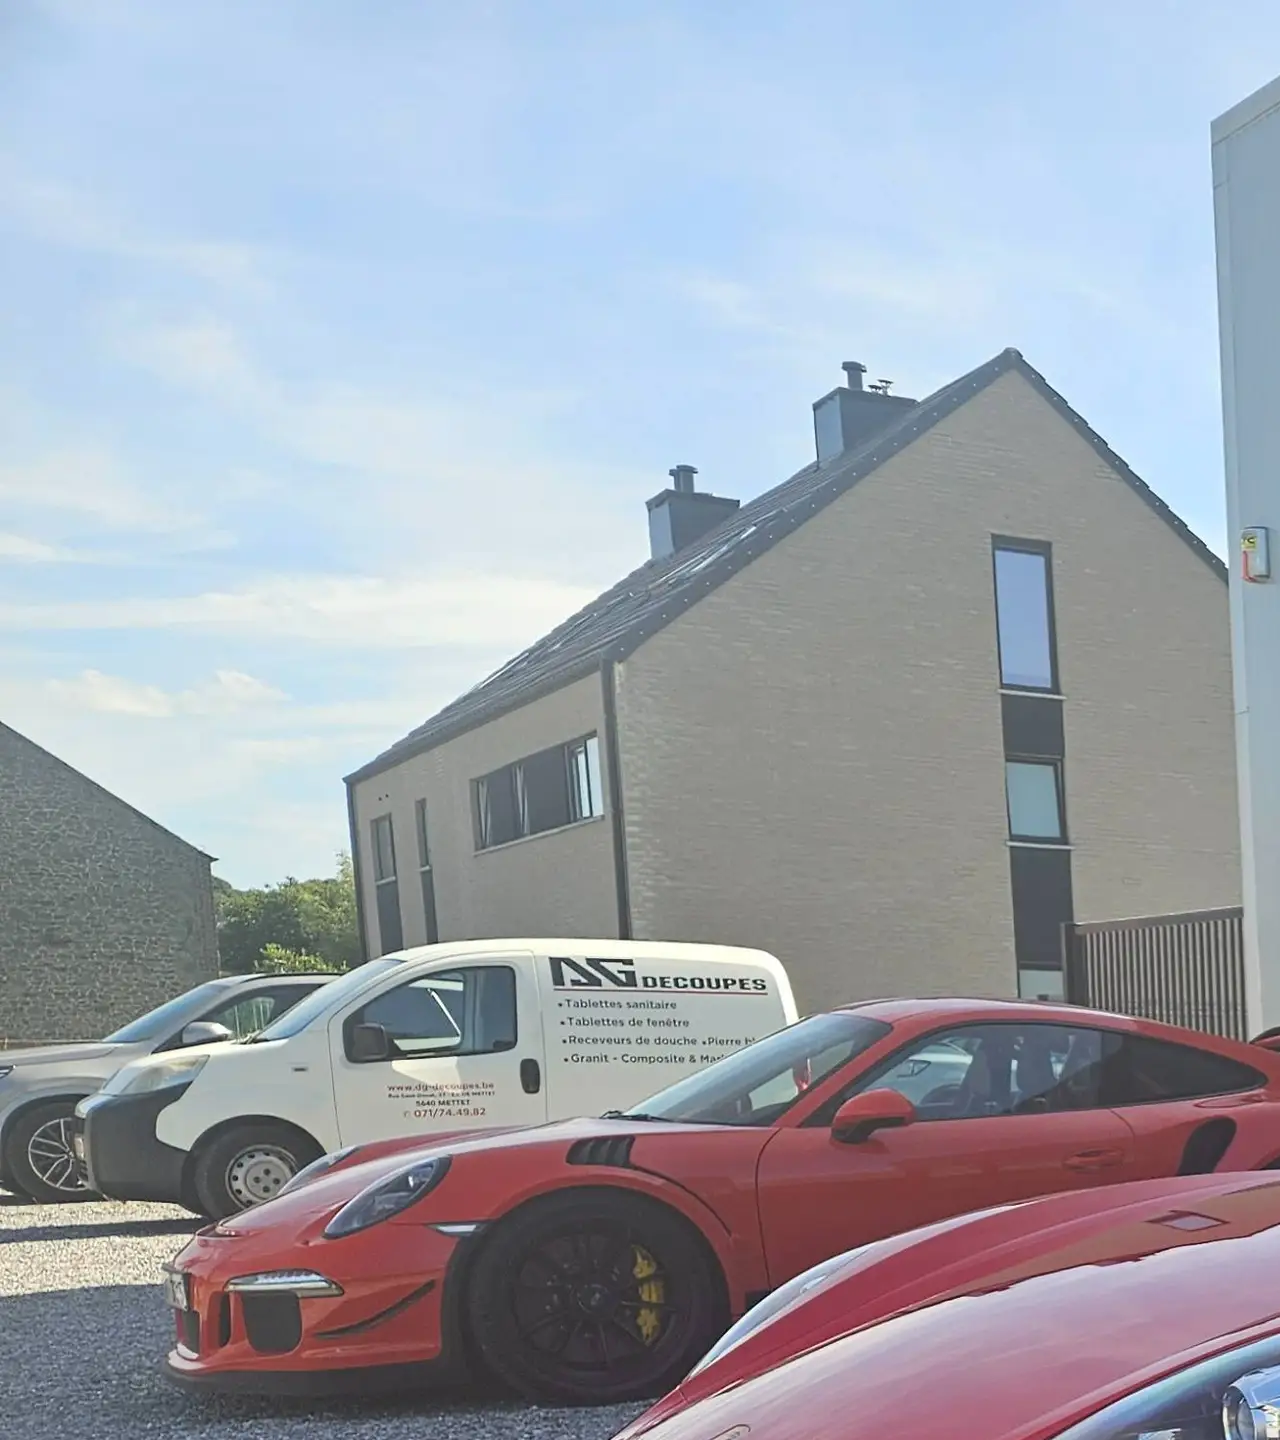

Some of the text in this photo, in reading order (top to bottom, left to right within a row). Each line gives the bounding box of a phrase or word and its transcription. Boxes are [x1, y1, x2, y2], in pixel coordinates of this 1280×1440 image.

[642, 975, 767, 990] DECOUPES
[565, 999, 677, 1009] Tablettes sanitaire
[567, 1017, 690, 1027] Tablettes de fenêtre
[568, 1035, 632, 1045] Receveurs
[635, 1035, 650, 1045] de
[654, 1036, 697, 1046] douche
[708, 1036, 741, 1046] Pierre
[571, 1053, 608, 1063] Granit
[621, 1053, 685, 1064] Composite
